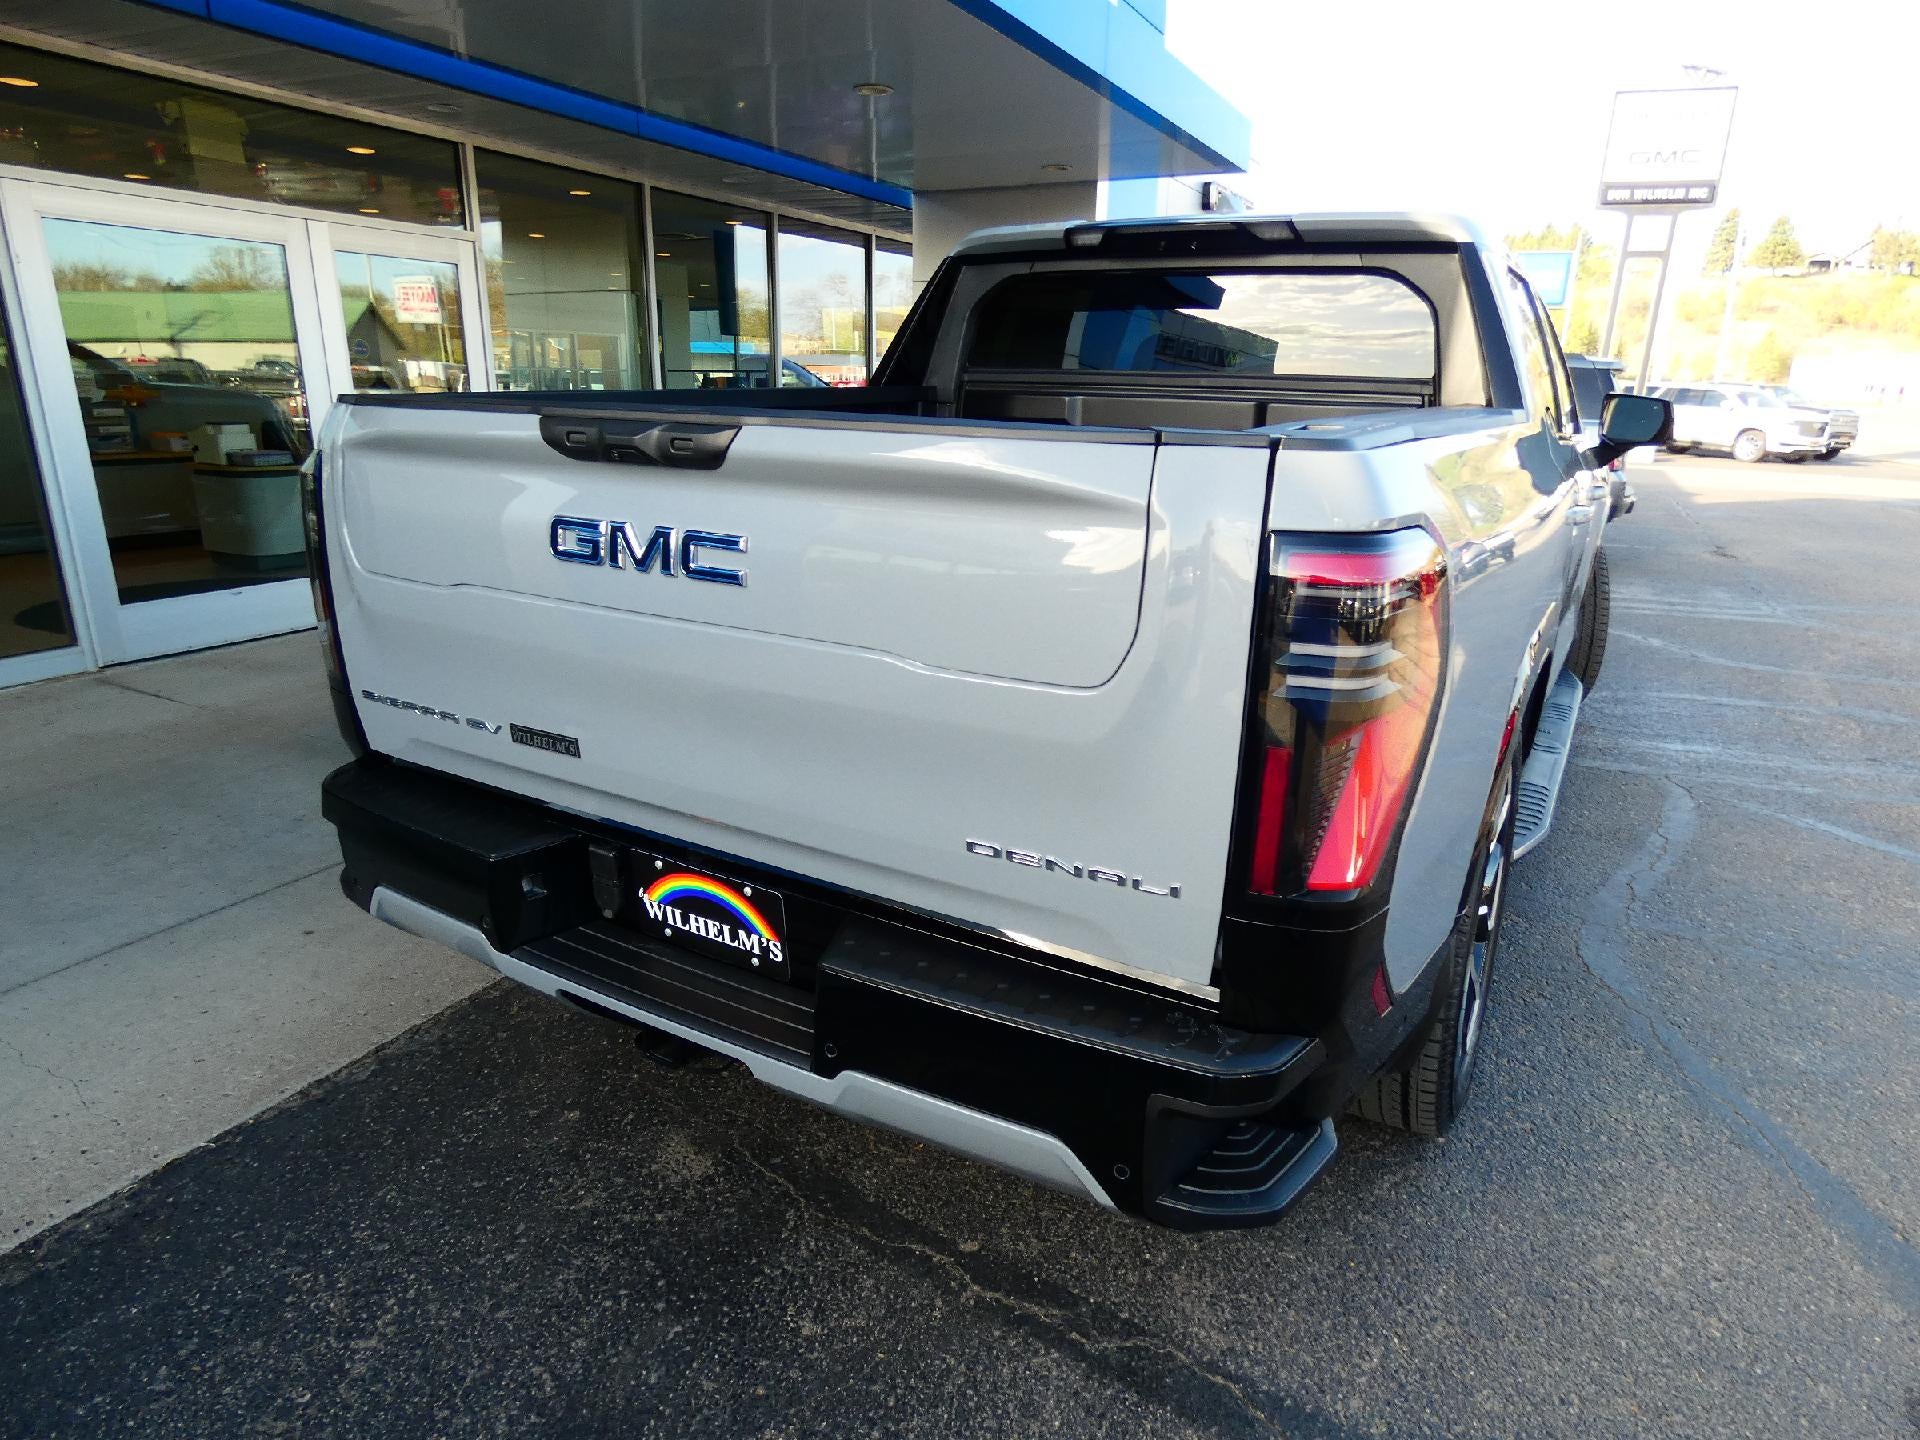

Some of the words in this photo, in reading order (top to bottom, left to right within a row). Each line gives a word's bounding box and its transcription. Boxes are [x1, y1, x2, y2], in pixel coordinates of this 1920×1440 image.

[1629, 150, 1702, 164] GMC
[550, 514, 749, 588] GMC
[361, 690, 460, 725] SIERRA
[465, 717, 502, 734] EV
[511, 727, 577, 756] WILHELM'S
[965, 837, 1182, 899] DENALI
